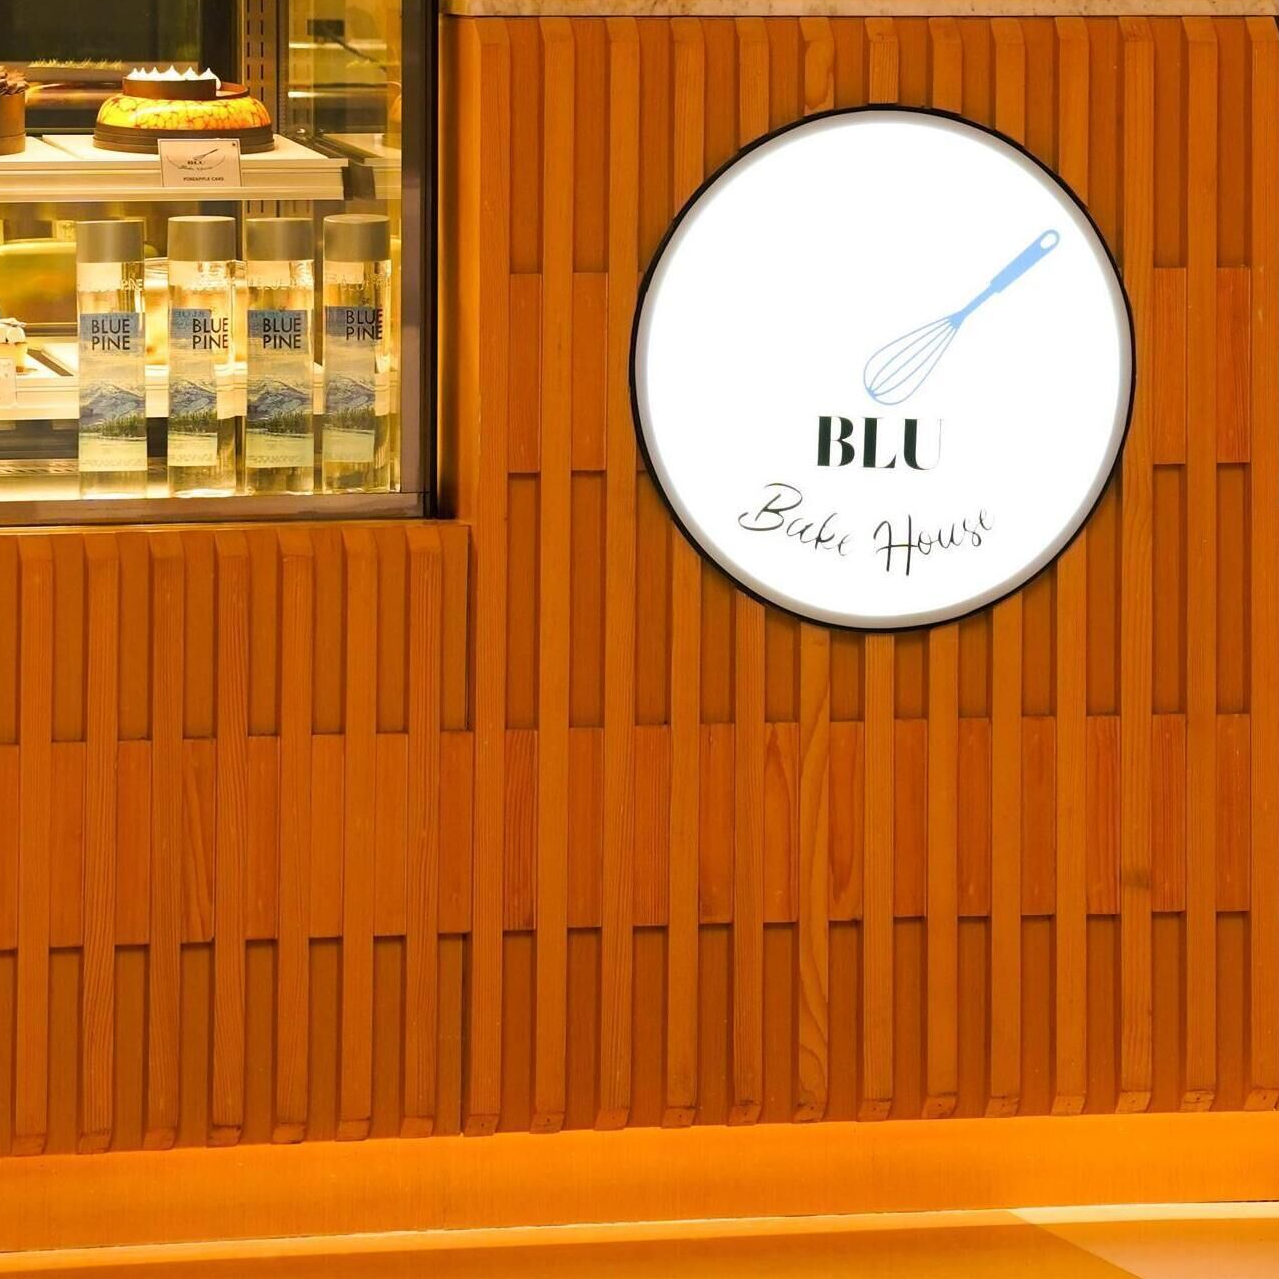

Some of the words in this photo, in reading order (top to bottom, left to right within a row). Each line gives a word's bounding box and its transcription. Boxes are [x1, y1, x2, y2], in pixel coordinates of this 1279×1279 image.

[347, 309, 383, 324] BLUE
[92, 319, 130, 333] BLUE
[193, 318, 228, 333] BLUE
[263, 318, 301, 332] BLUE
[346, 326, 382, 340] PINE
[92, 336, 130, 350] PINE
[193, 335, 228, 349] PINE
[263, 334, 301, 349] PINE
[816, 415, 944, 471] BLU
[737, 483, 854, 557] Bake
[873, 508, 995, 576] House
